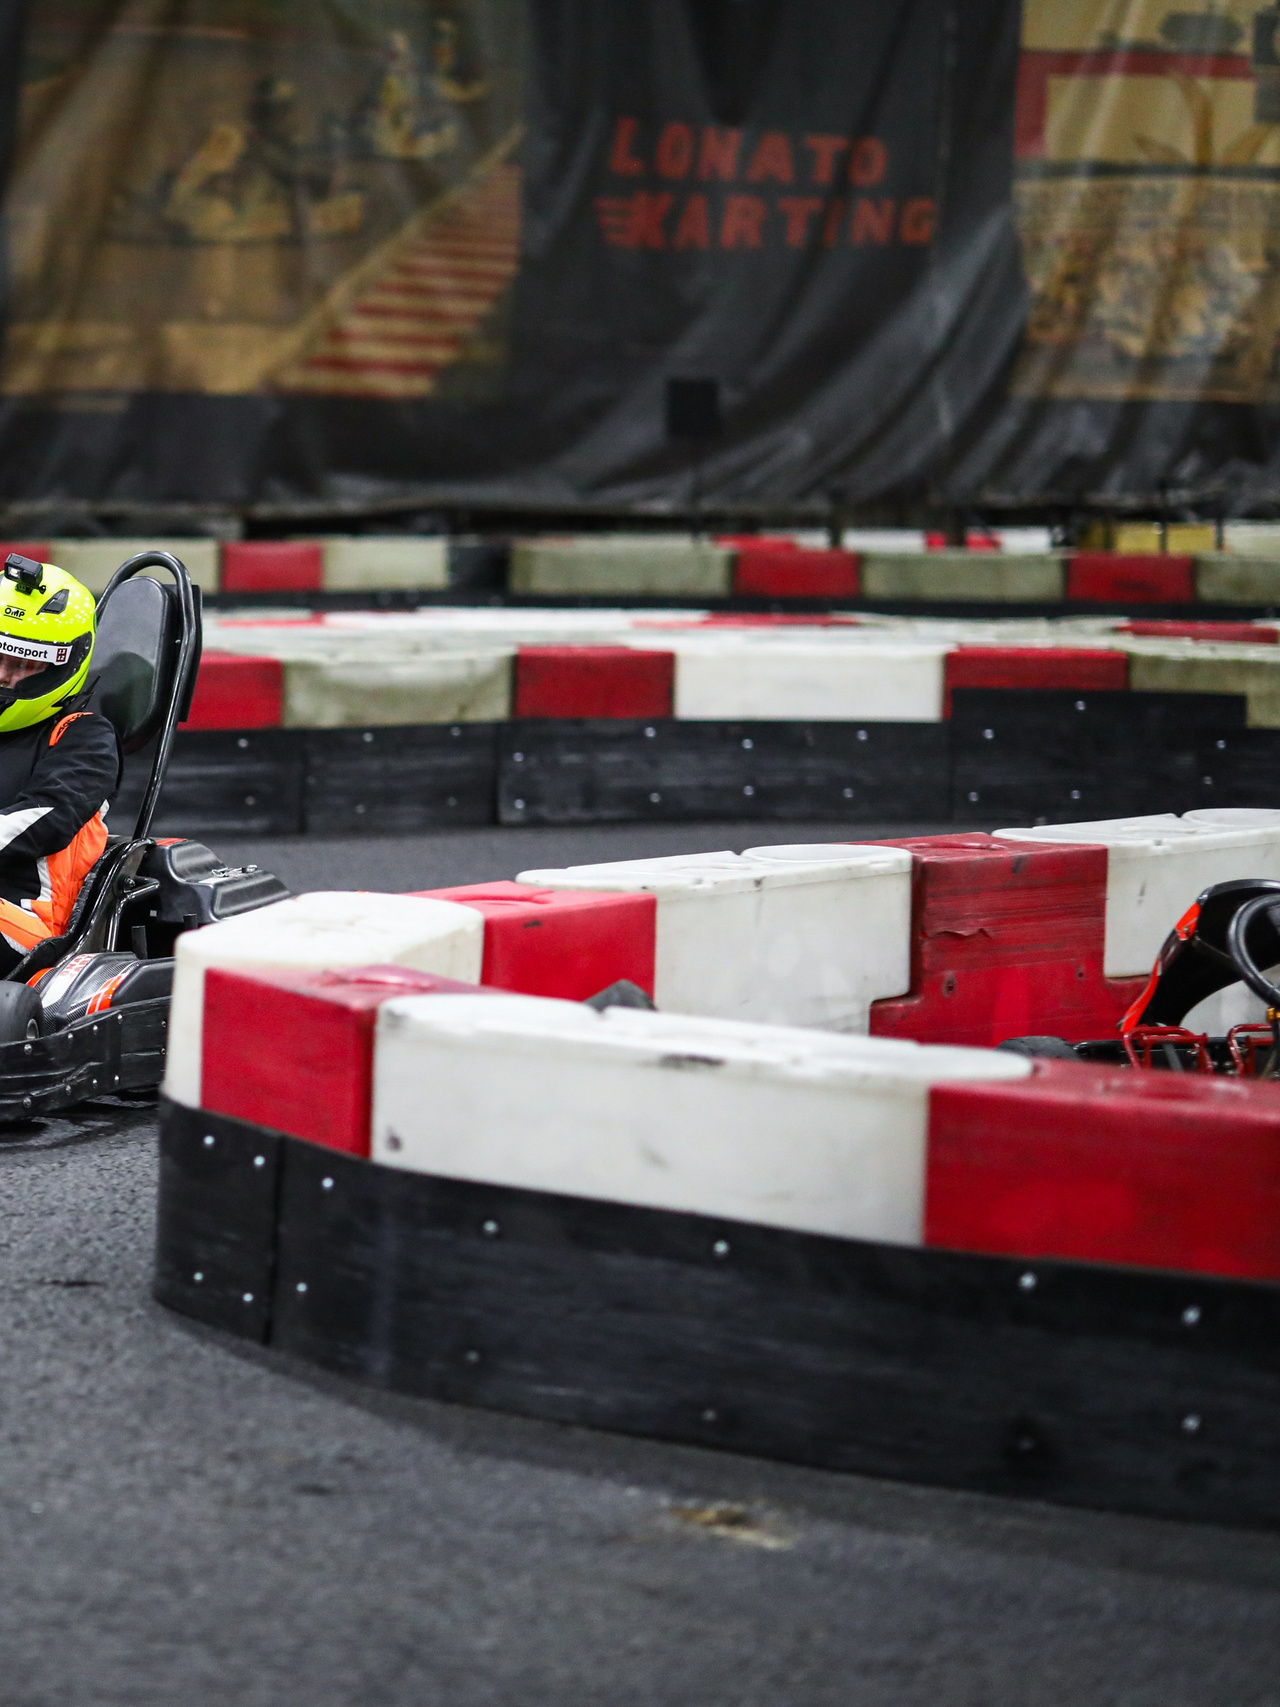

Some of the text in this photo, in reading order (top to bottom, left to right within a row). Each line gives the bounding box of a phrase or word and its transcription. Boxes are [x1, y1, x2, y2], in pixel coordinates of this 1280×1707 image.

[610, 117, 889, 187] LONATO
[613, 191, 935, 249] KARTING
[4, 607, 25, 618] OMP
